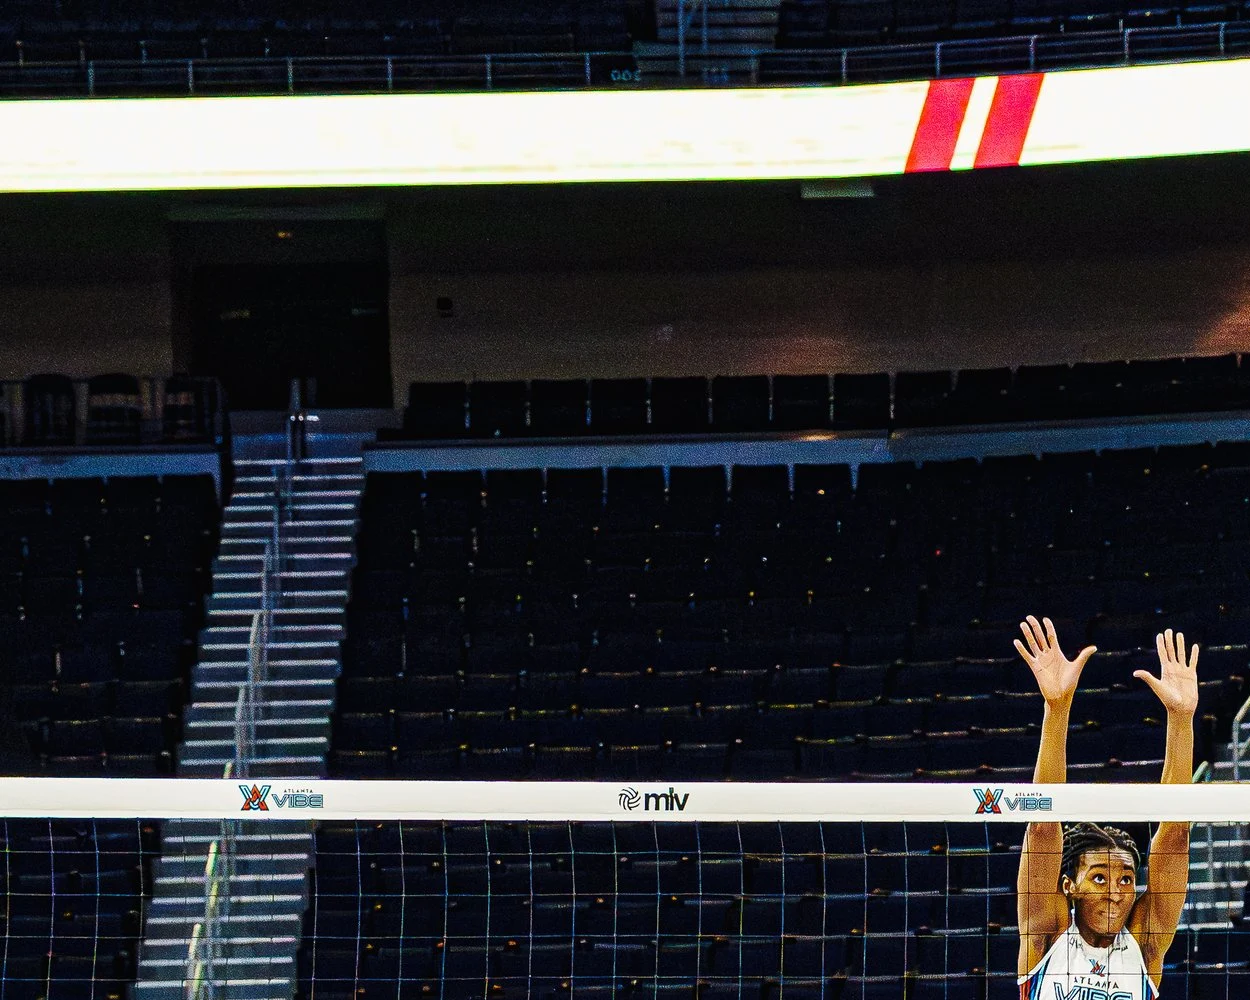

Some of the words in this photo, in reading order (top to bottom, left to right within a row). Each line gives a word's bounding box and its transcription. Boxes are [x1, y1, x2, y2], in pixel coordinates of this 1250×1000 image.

[271, 794, 324, 808] VIBE
[644, 787, 689, 811] mlv
[1003, 797, 1053, 811] VIBE
[1074, 976, 1119, 989] ATLANTA
